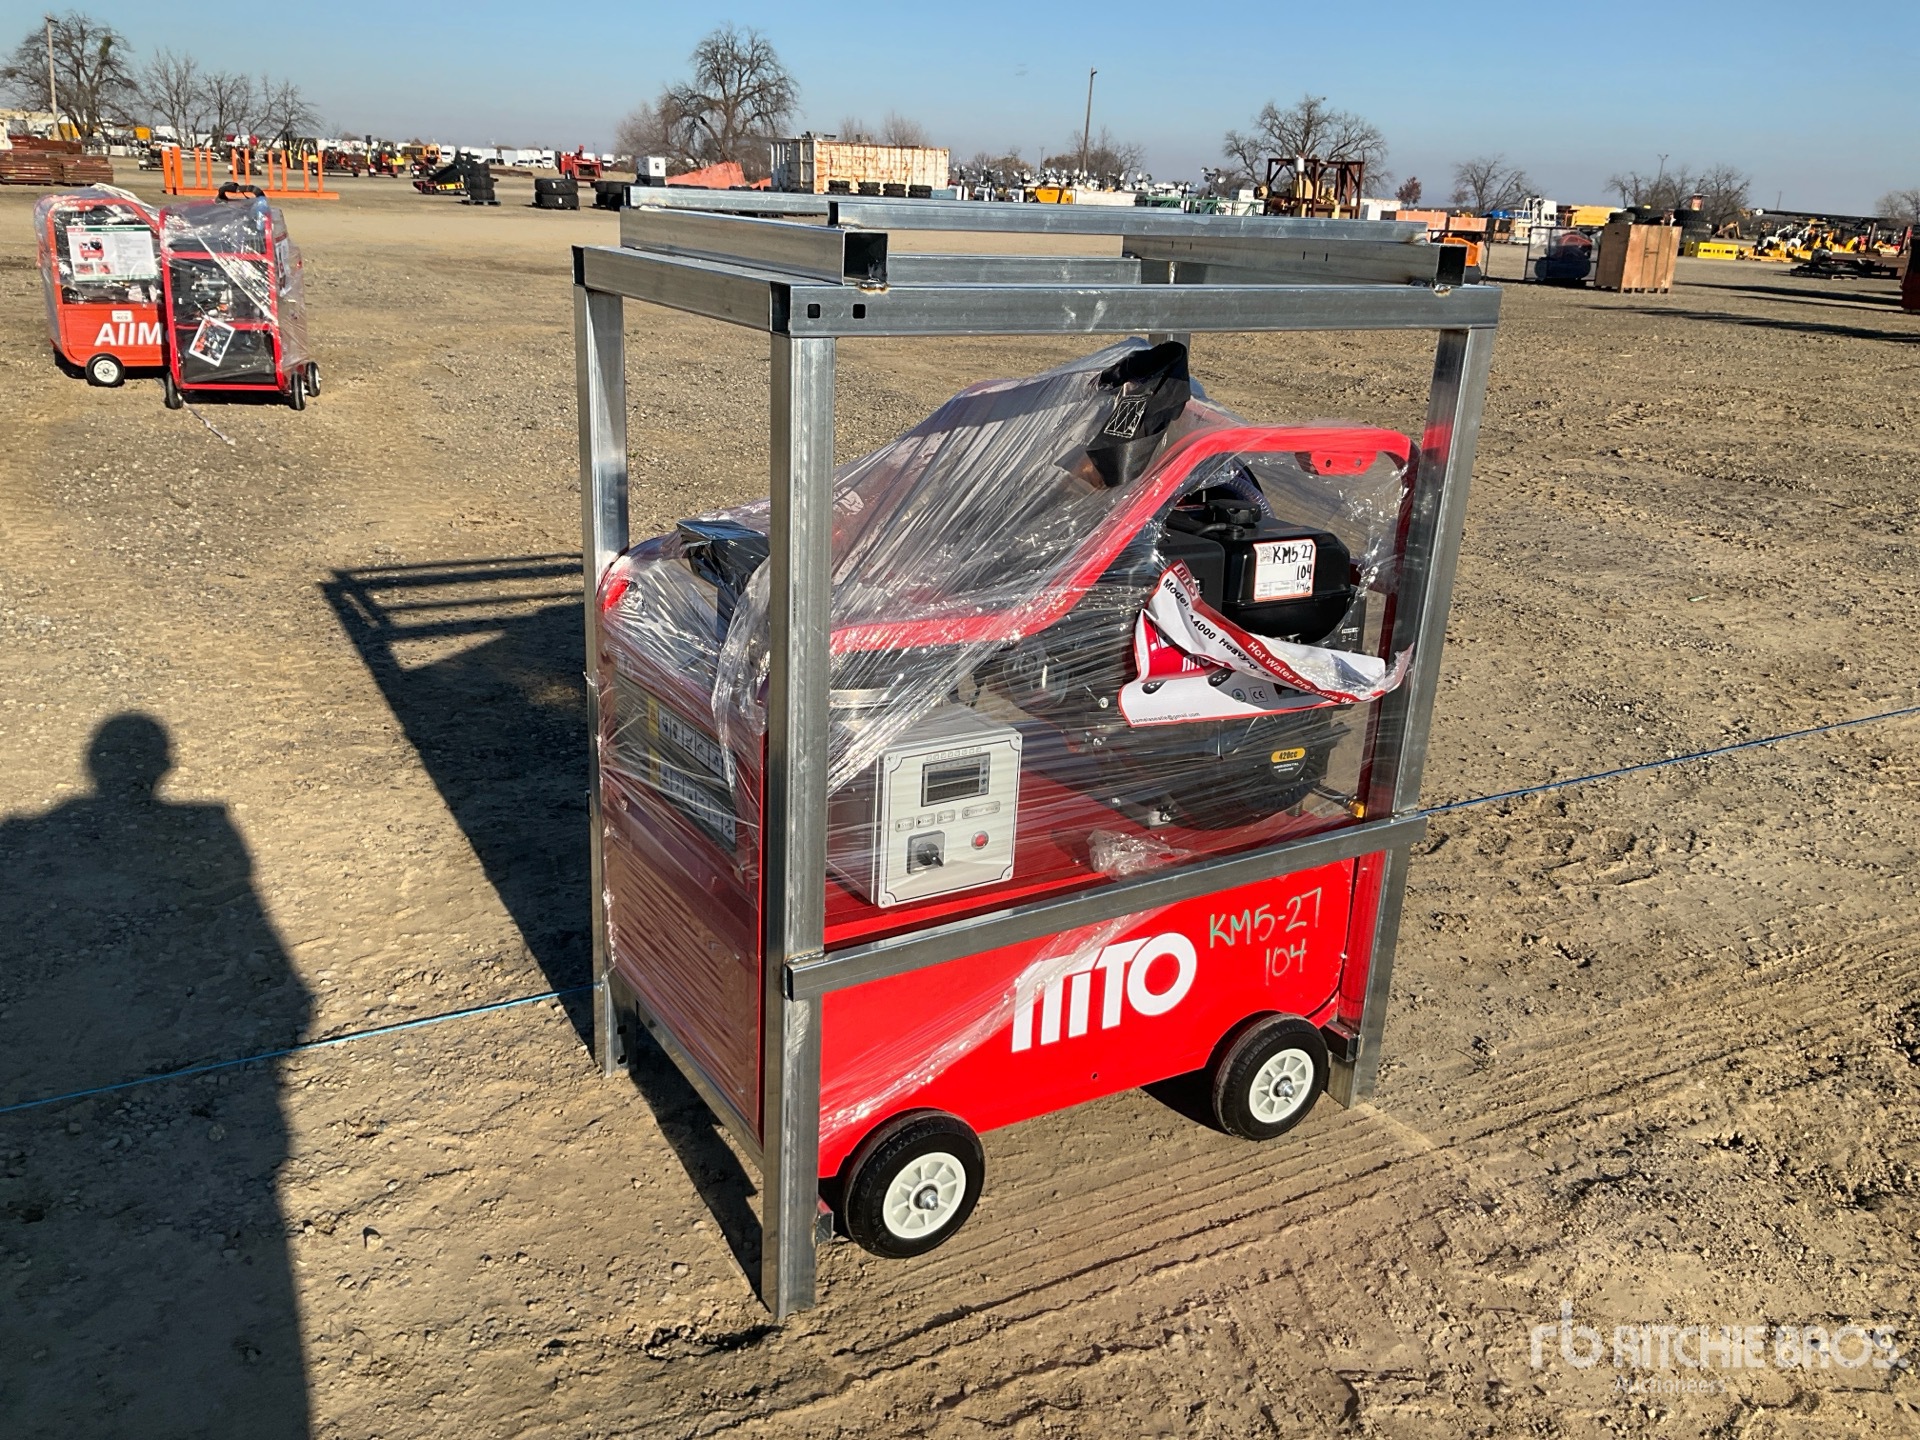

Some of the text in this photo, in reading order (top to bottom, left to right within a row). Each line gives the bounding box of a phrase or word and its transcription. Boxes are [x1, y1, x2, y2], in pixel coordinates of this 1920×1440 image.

[1272, 544, 1314, 564] KM5 27
[1296, 563, 1313, 580] 104
[1247, 641, 1267, 660] Hot
[1265, 657, 1295, 680] Water
[1278, 750, 1299, 760] 420cc
[1209, 887, 1322, 949] KM5-27
[1265, 938, 1307, 986] 104
